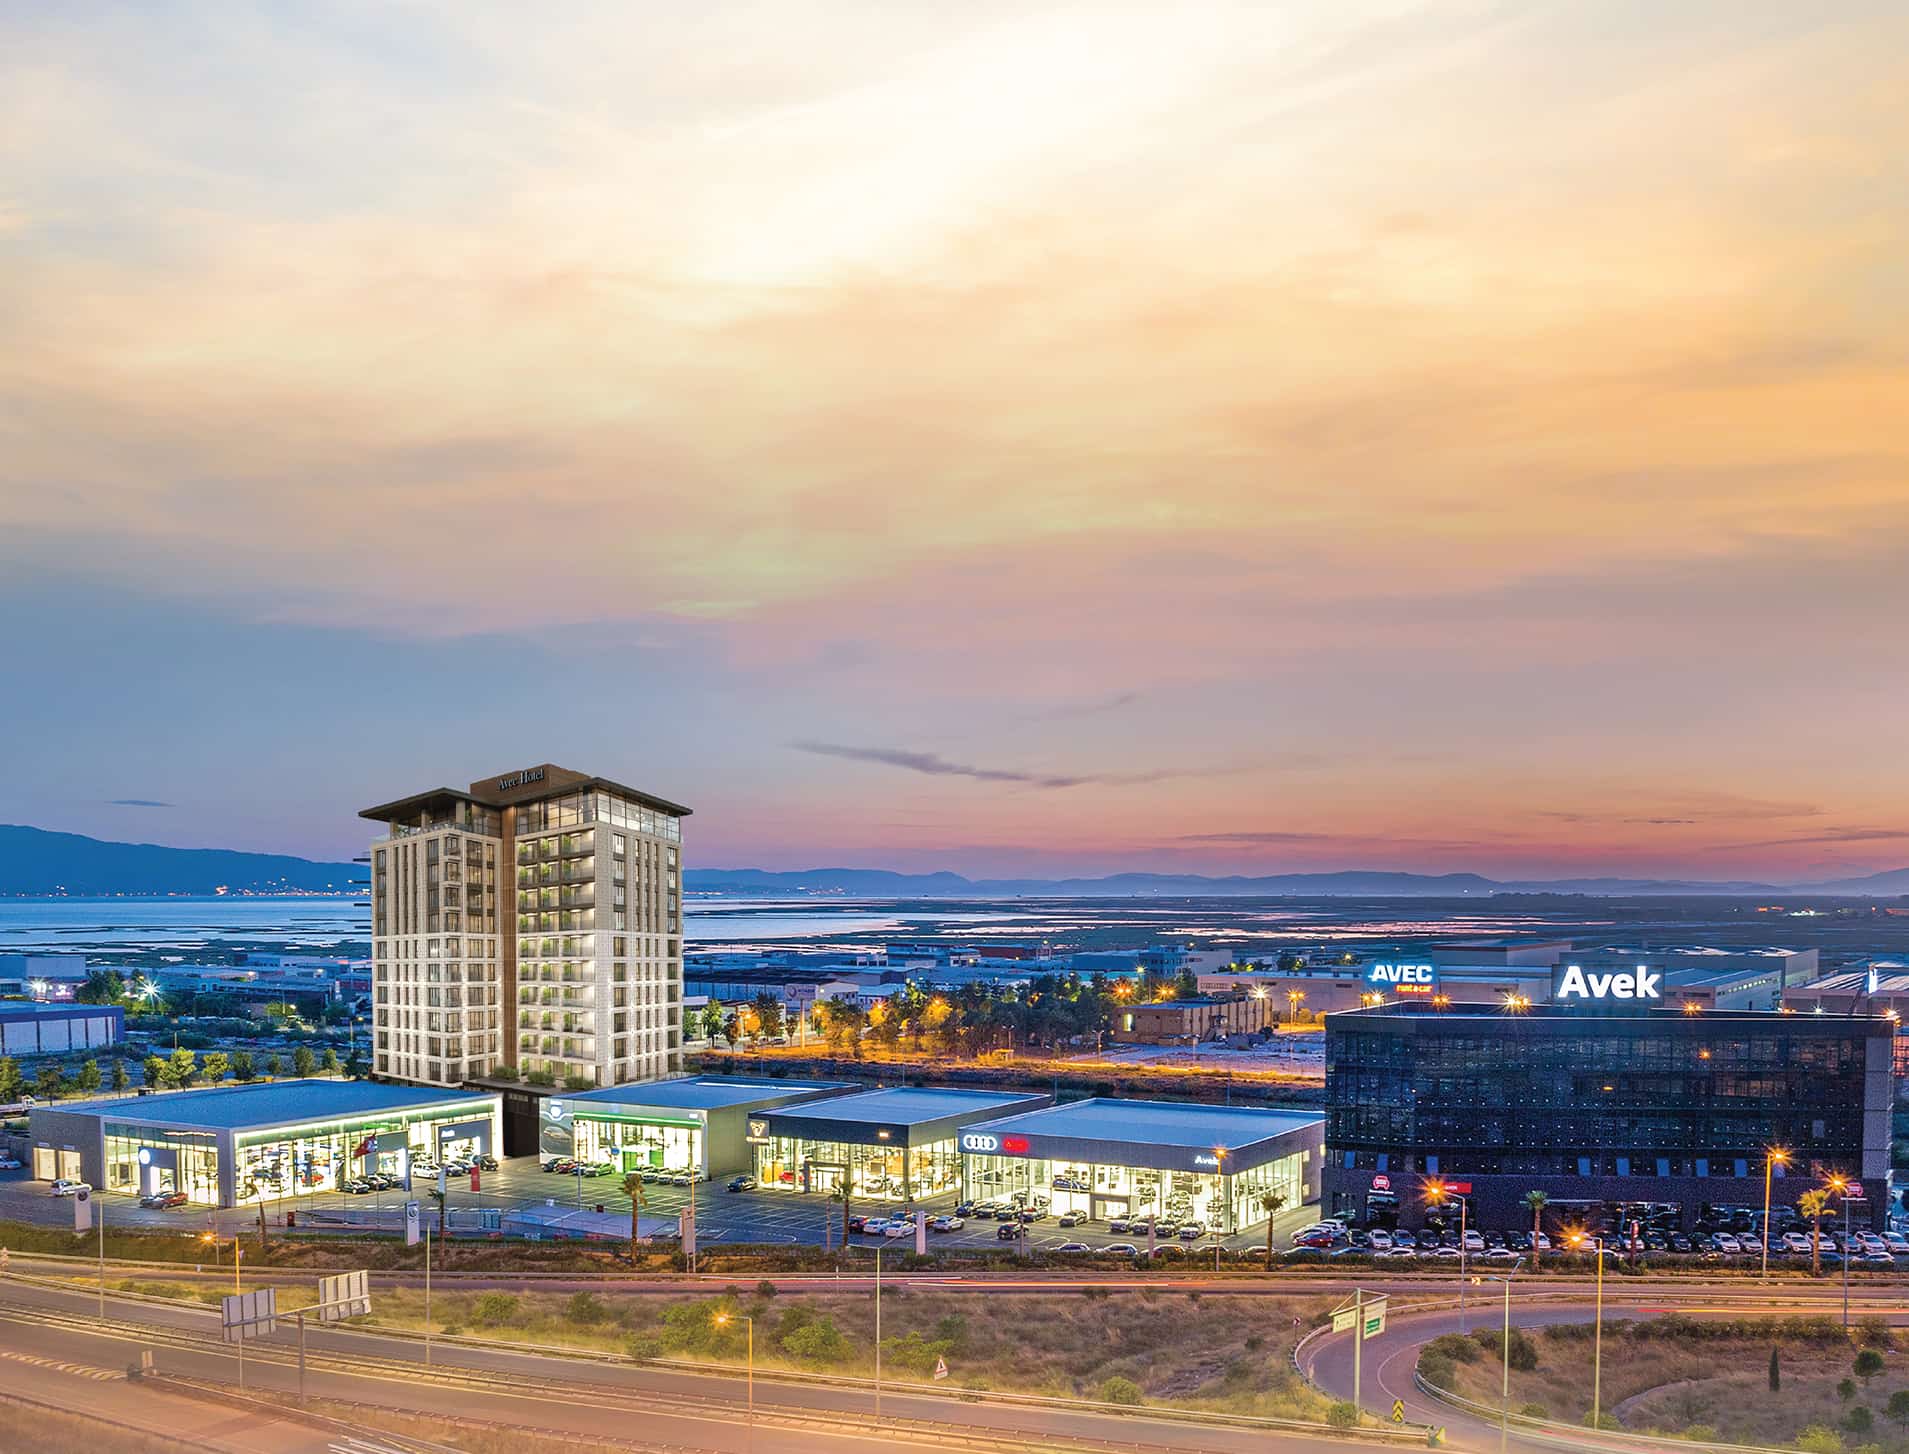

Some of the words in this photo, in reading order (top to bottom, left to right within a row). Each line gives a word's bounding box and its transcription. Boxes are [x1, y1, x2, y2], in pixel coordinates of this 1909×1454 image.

[520, 768, 544, 784] Hotel
[1368, 964, 1433, 982] AVEC
[1558, 965, 1661, 998] Avek
